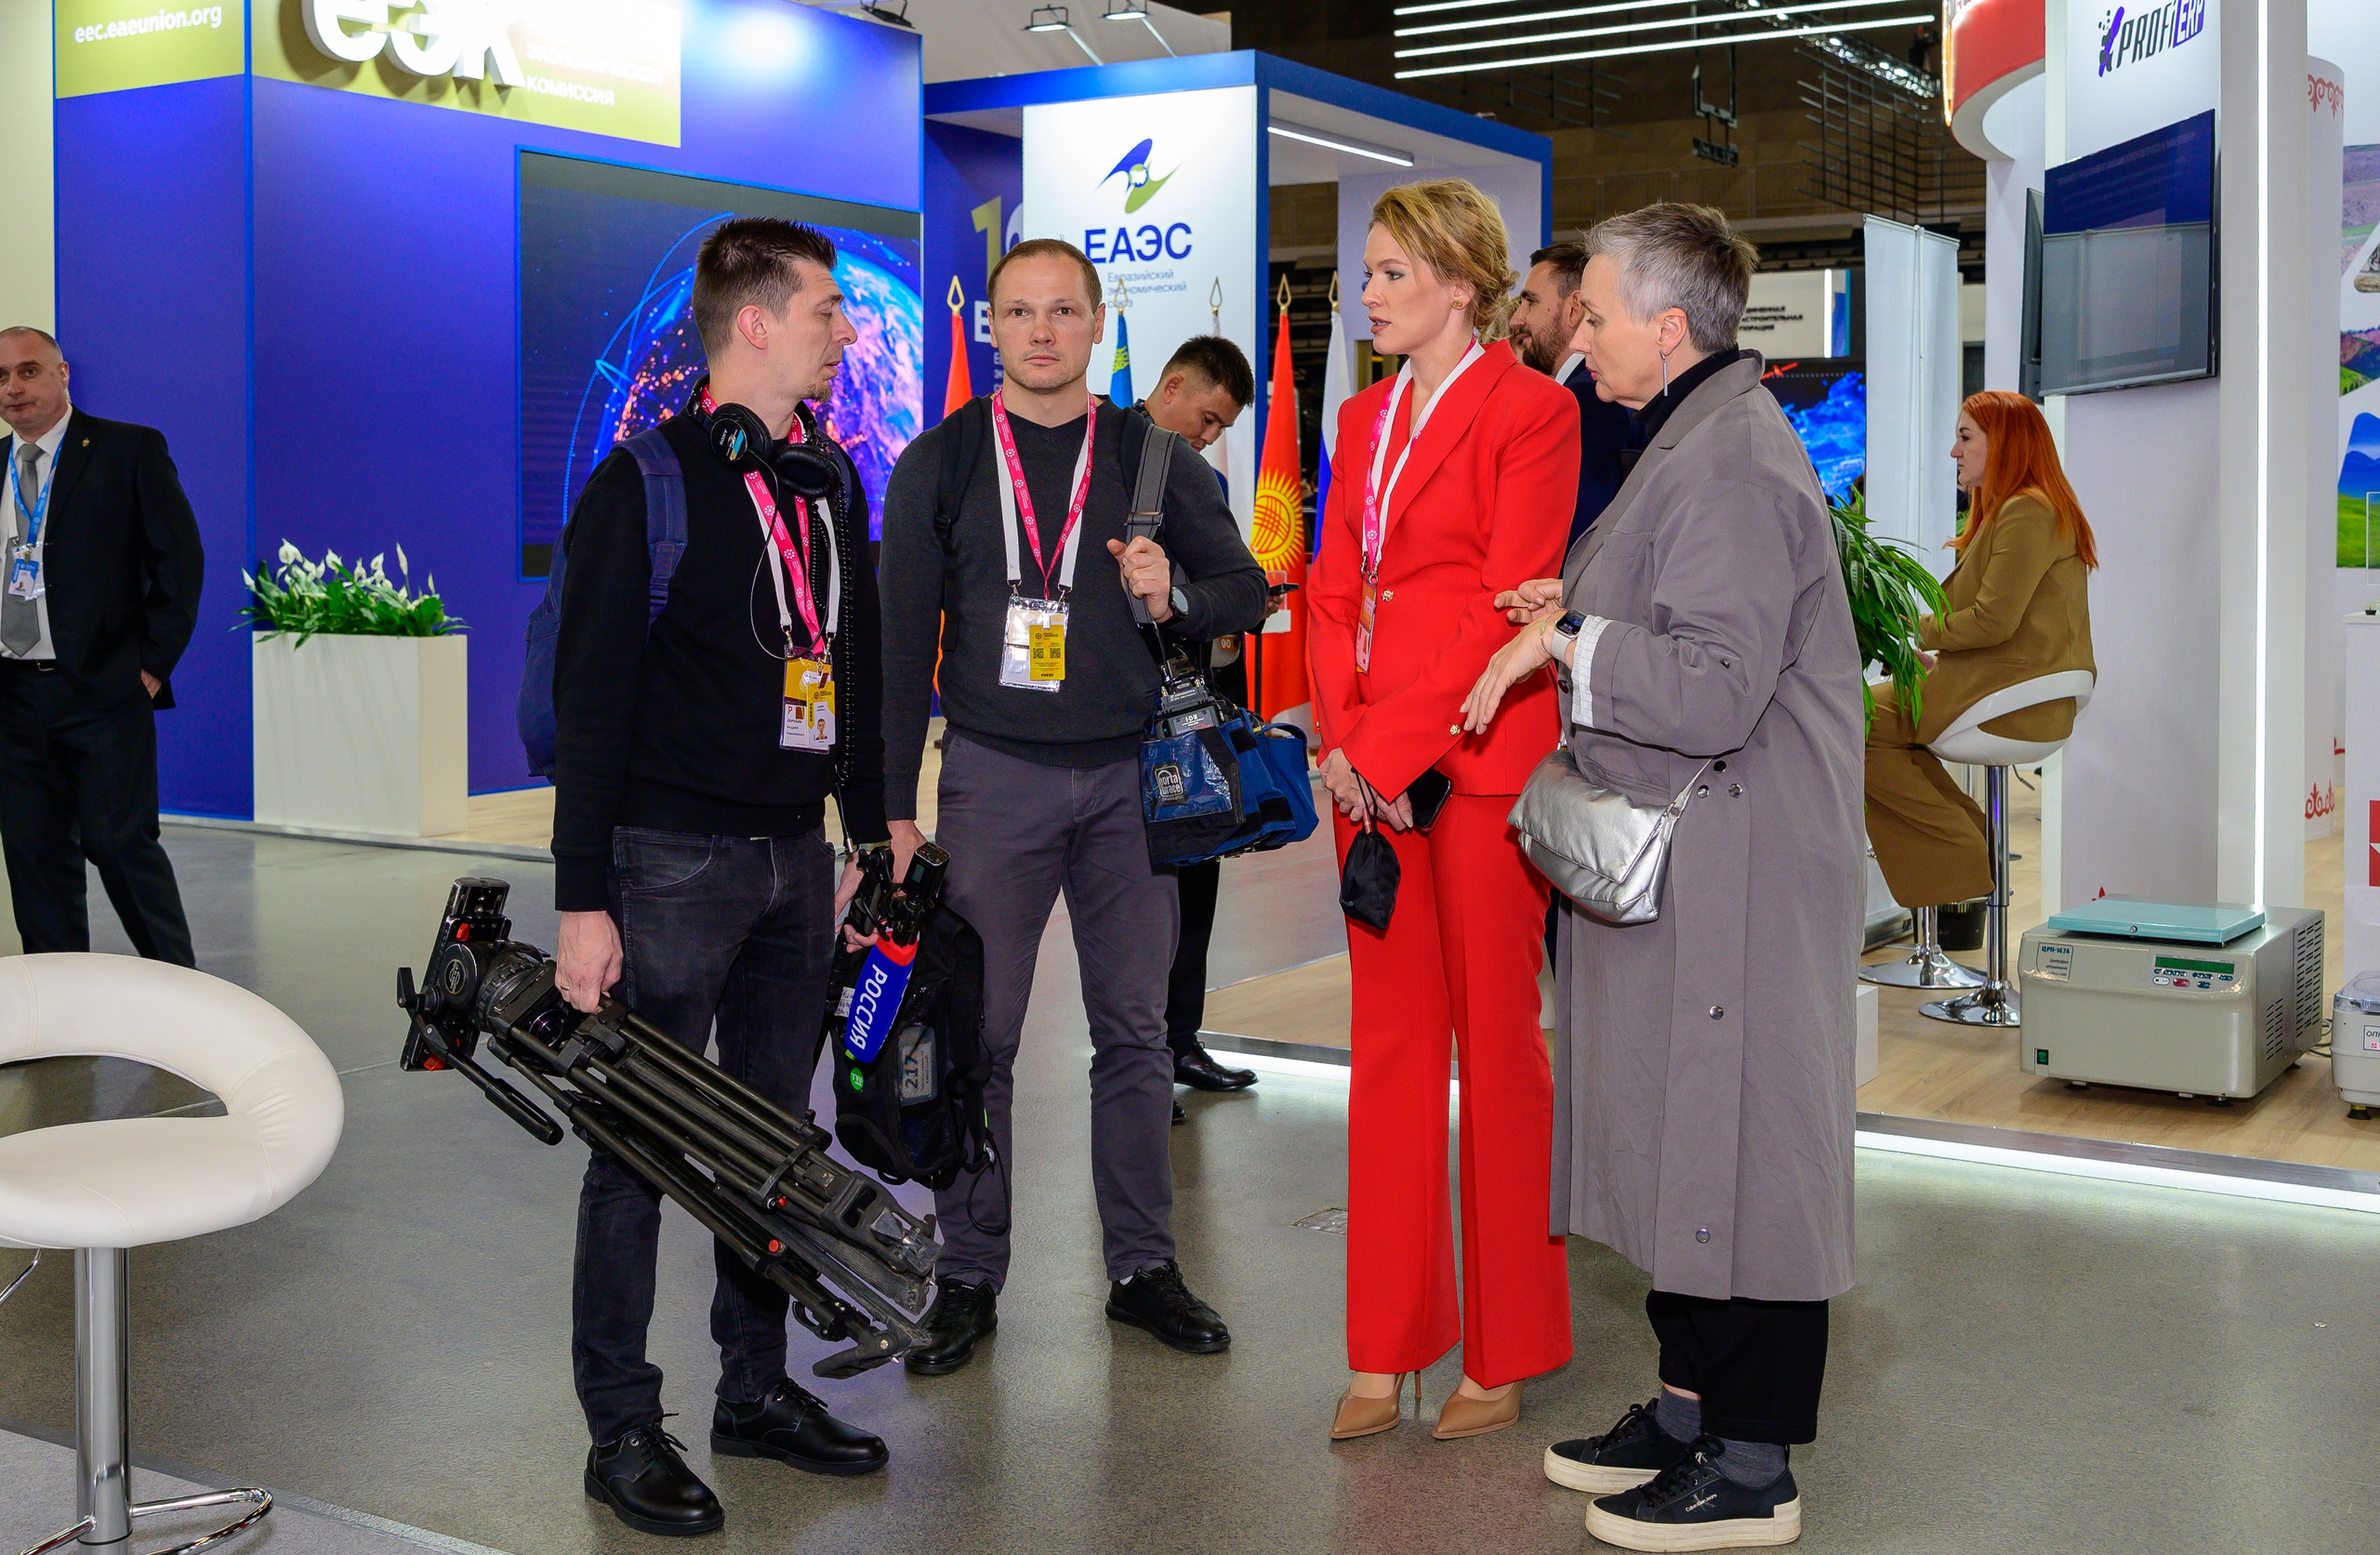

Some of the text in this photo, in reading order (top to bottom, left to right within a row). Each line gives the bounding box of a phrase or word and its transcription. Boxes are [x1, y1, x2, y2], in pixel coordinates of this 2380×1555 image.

[73, 6, 223, 43] eec.eaeunion.org
[1085, 222, 1193, 264] ЕАЭС
[850, 964, 888, 1050] РОССИЯ
